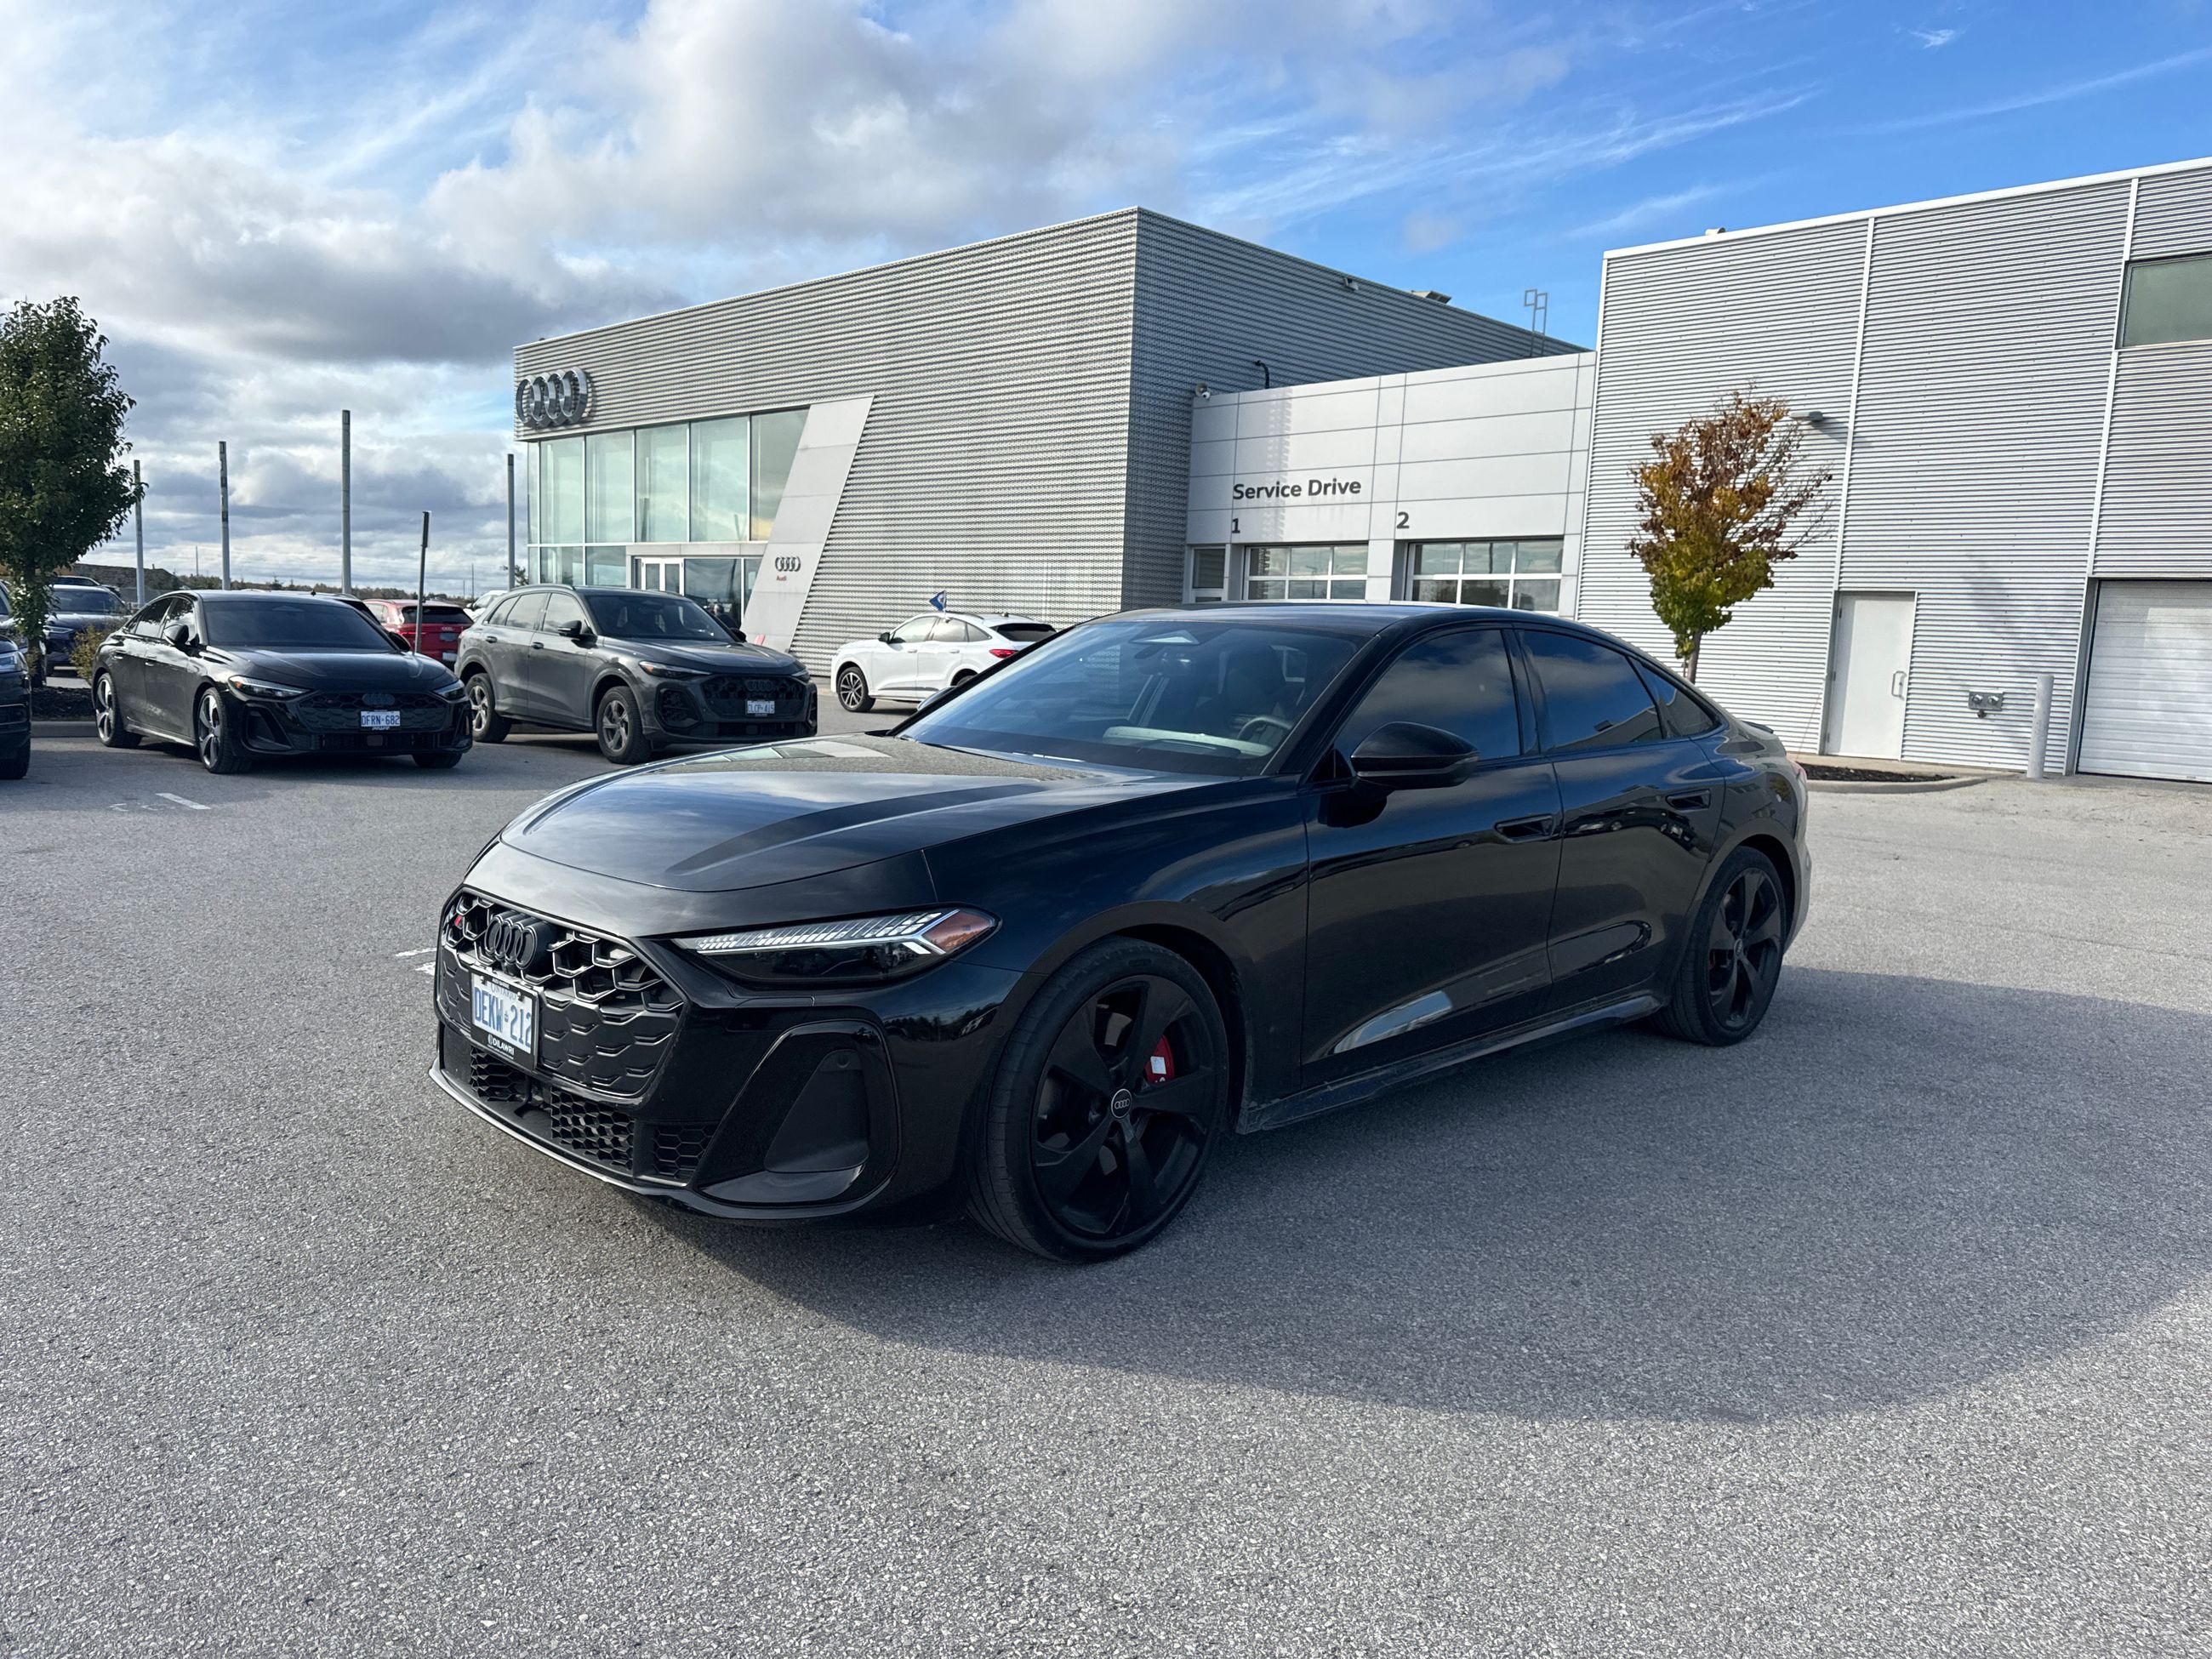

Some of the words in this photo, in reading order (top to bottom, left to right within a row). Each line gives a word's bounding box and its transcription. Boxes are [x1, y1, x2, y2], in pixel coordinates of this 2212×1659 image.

[1233, 481, 1303, 499] Service
[1308, 478, 1361, 496] Drive
[1232, 517, 1240, 533] 1
[1396, 511, 1410, 529] 2
[362, 715, 381, 725] DFRN
[385, 715, 400, 725] 682
[474, 987, 504, 1033] DEKW
[493, 1037, 515, 1056] DILAWRI
